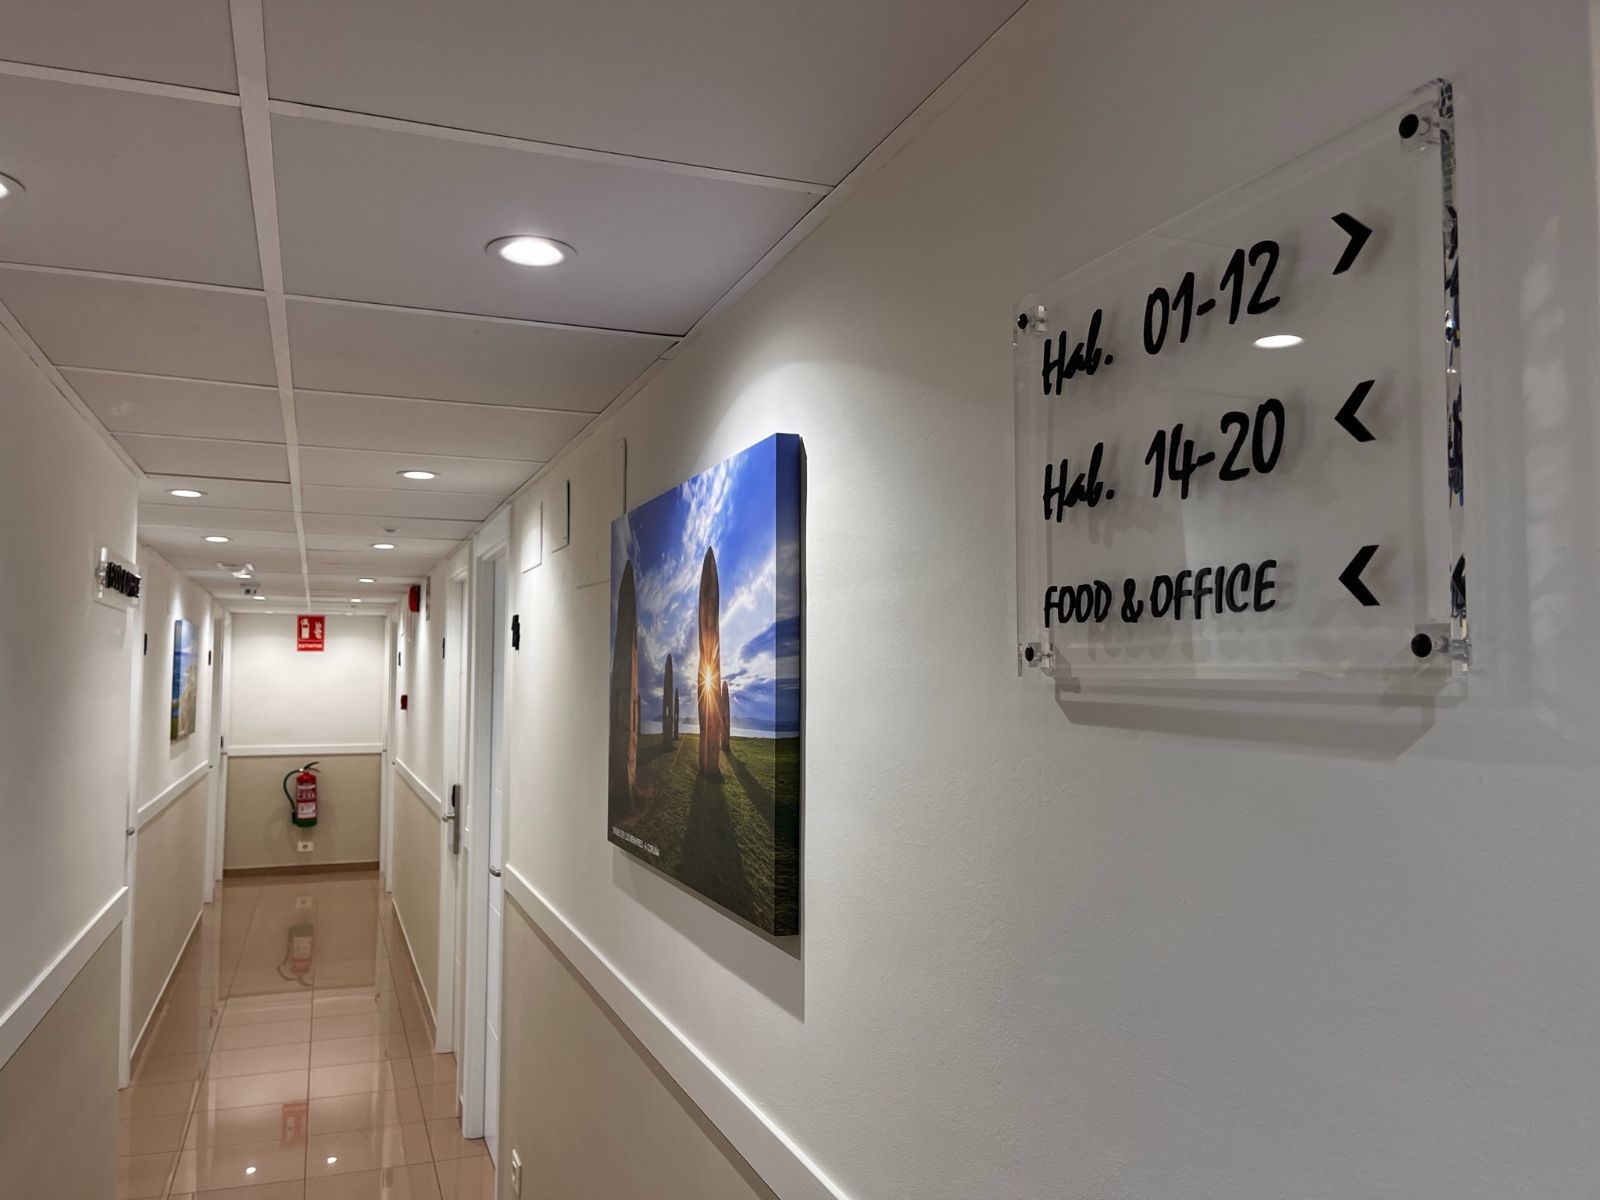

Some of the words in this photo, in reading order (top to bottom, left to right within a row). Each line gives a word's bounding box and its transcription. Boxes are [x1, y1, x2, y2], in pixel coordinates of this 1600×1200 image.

[1042, 309, 1114, 395] Hab.
[1144, 240, 1280, 354] 01-12
[1043, 442, 1115, 522] Hab.
[1145, 398, 1285, 499] 14-20
[1044, 579, 1112, 628] FOOD
[1121, 578, 1144, 623] &
[1150, 560, 1277, 621] OFFICE
